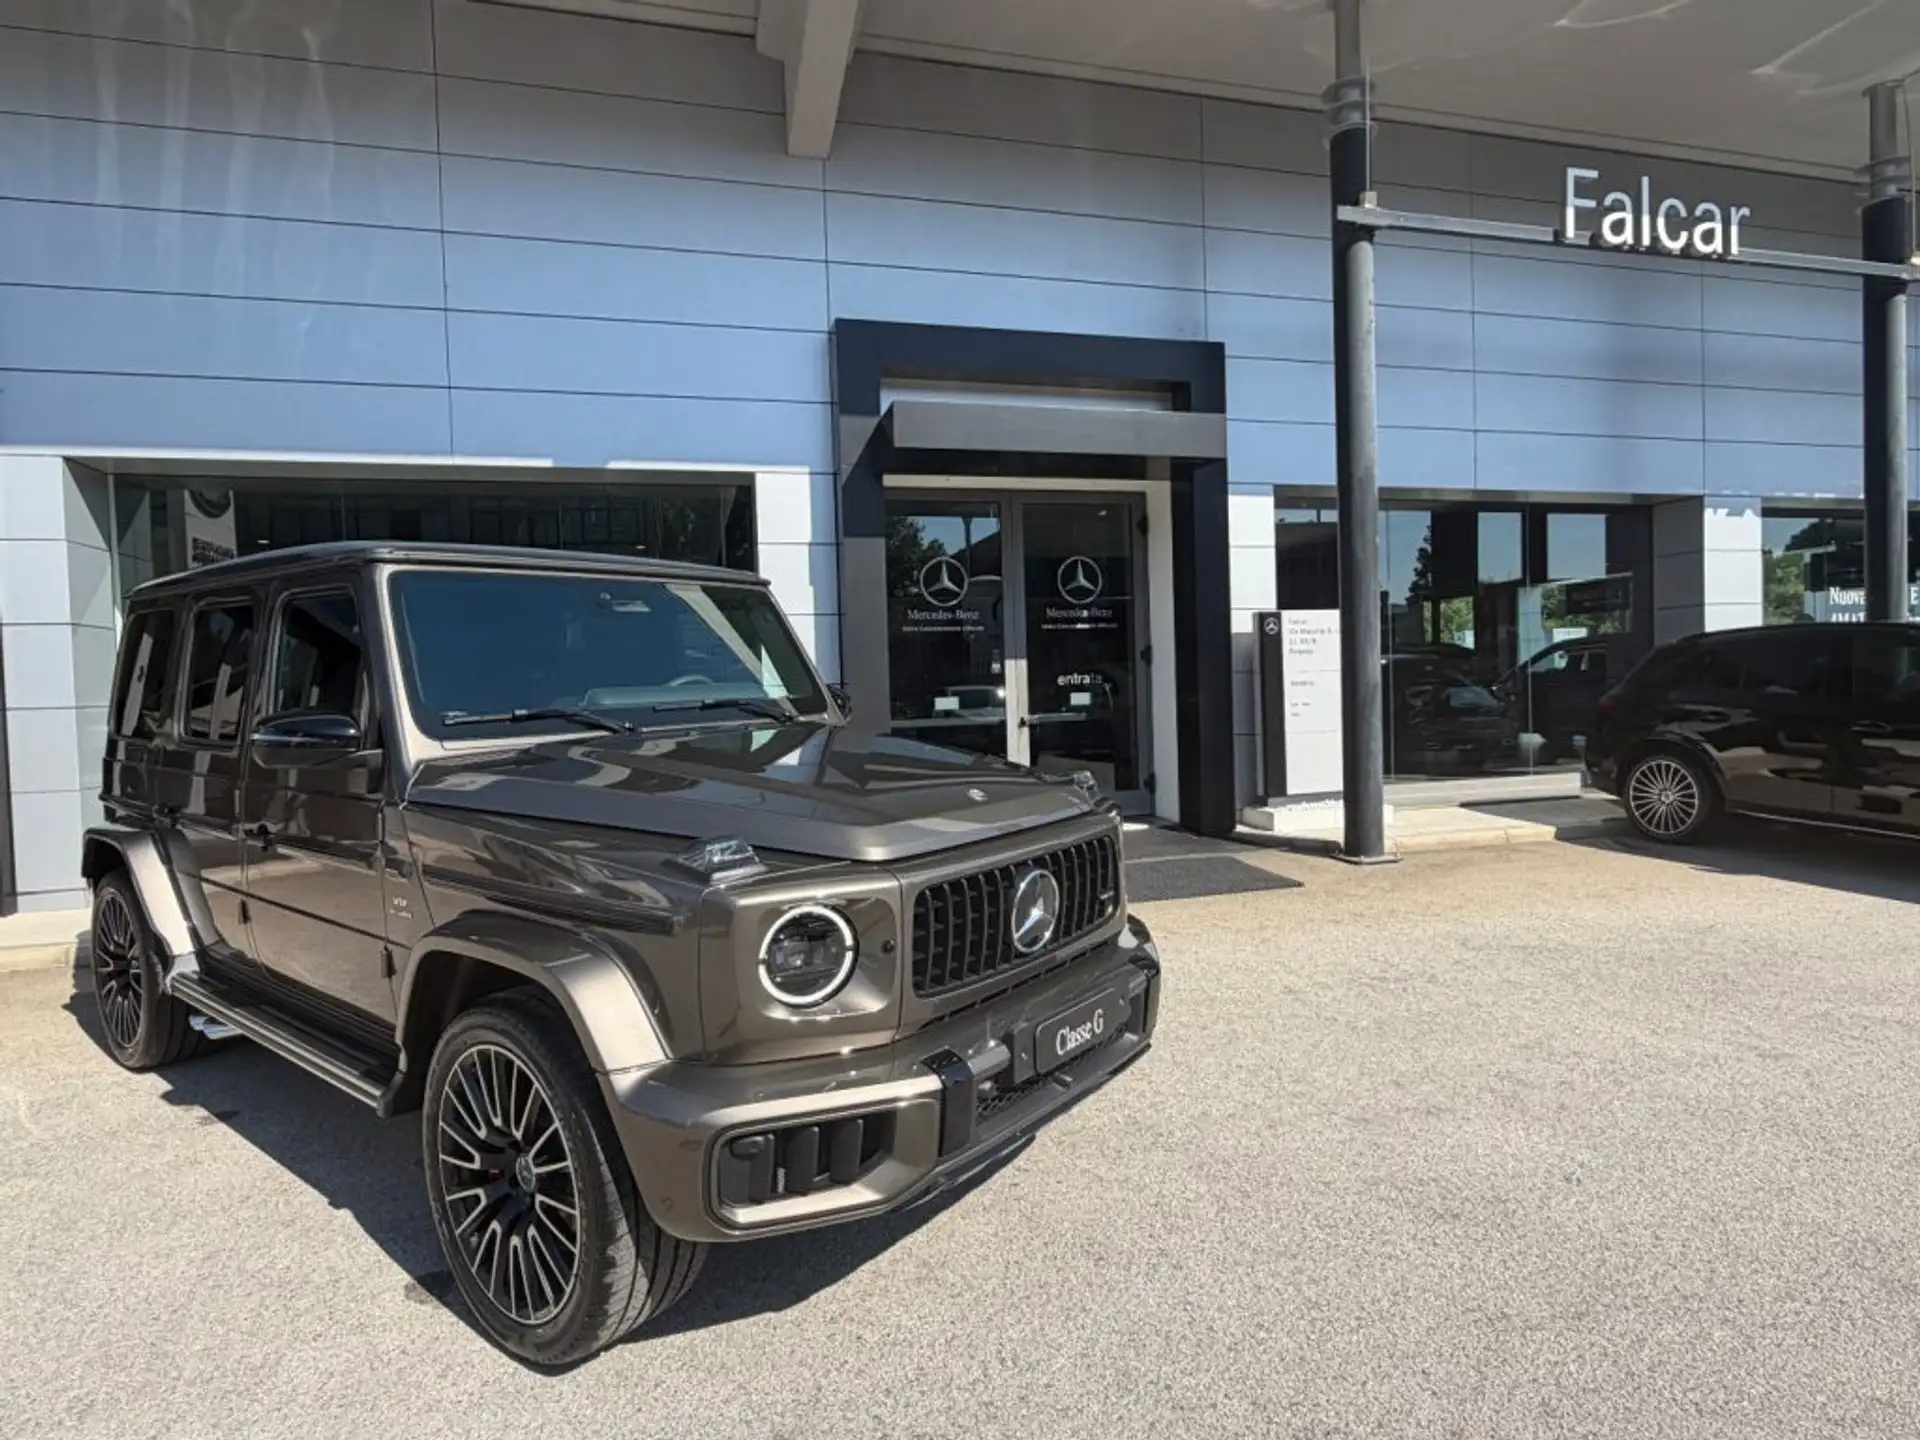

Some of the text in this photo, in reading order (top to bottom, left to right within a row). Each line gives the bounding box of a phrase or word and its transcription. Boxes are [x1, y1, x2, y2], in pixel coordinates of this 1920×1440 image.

[1565, 166, 1751, 256] Falcar
[907, 609, 980, 620] Mercedes-Benz
[1057, 671, 1102, 686] entrata
[1055, 1008, 1104, 1056] Classe G
